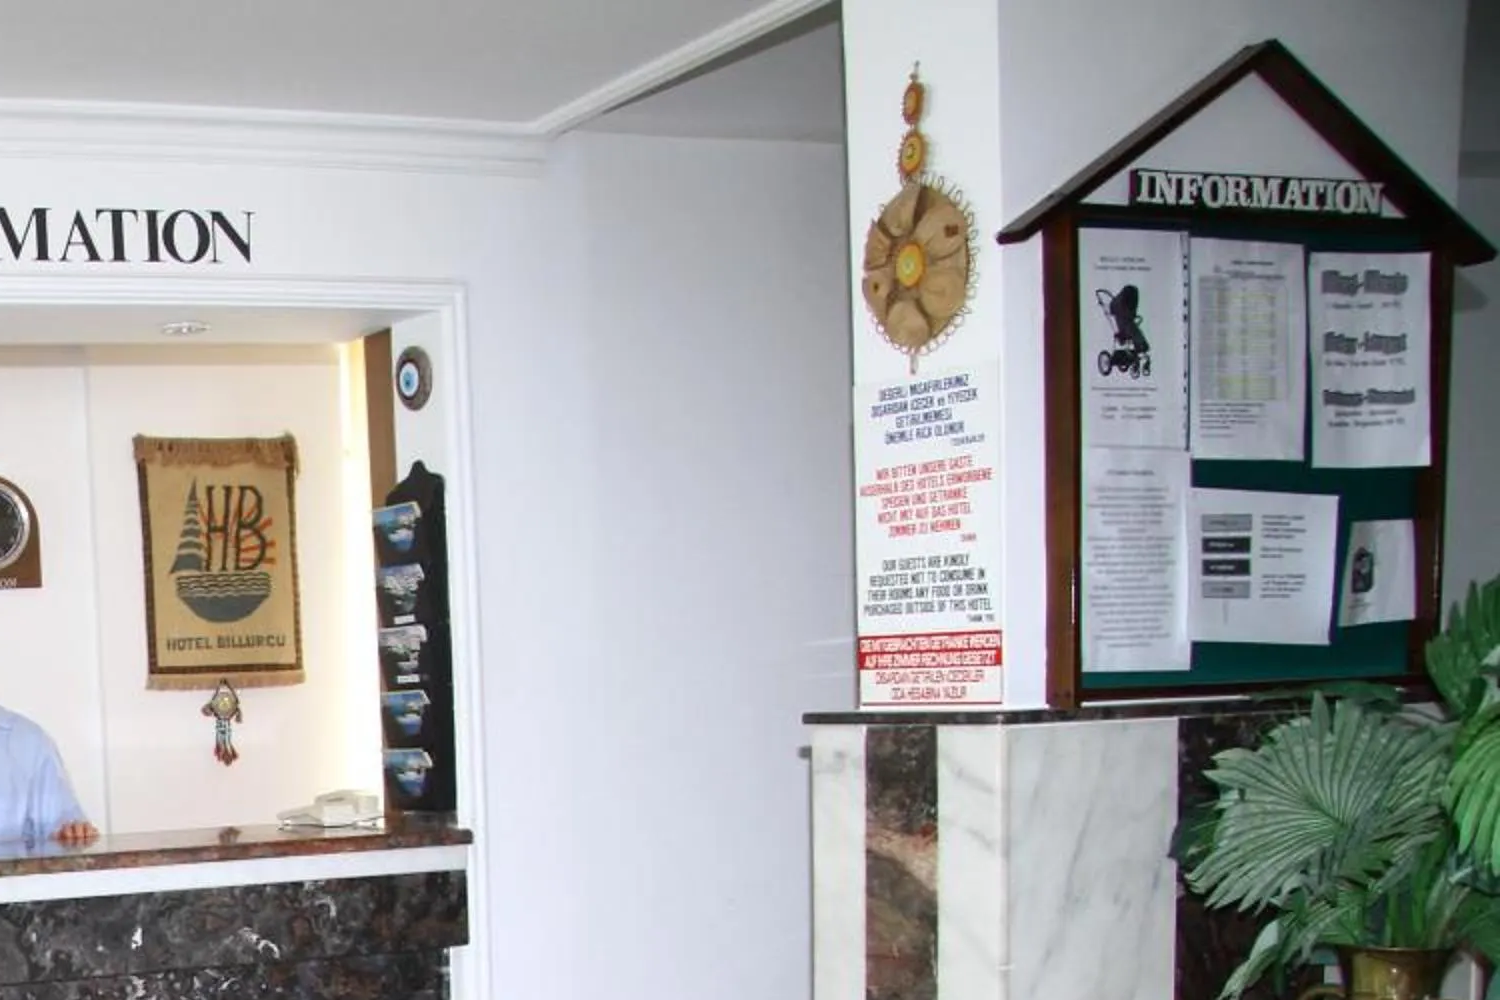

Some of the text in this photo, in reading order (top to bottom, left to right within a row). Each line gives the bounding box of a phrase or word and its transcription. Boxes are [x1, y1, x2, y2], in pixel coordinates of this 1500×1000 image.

[1136, 170, 1384, 215] INFORMATION
[205, 485, 266, 572] HB
[882, 553, 970, 572] OUR GUESTS ARE KINDLY
[869, 567, 986, 587] REQUESTED NOT TO CONSUME IN
[867, 582, 988, 601] THEIR ROOMS ANY FOOD OR DRINK
[863, 597, 993, 616] PURCHASED OUTSIDE OF THIS HOTEL
[167, 633, 286, 652] HOTEL BILLURCU
